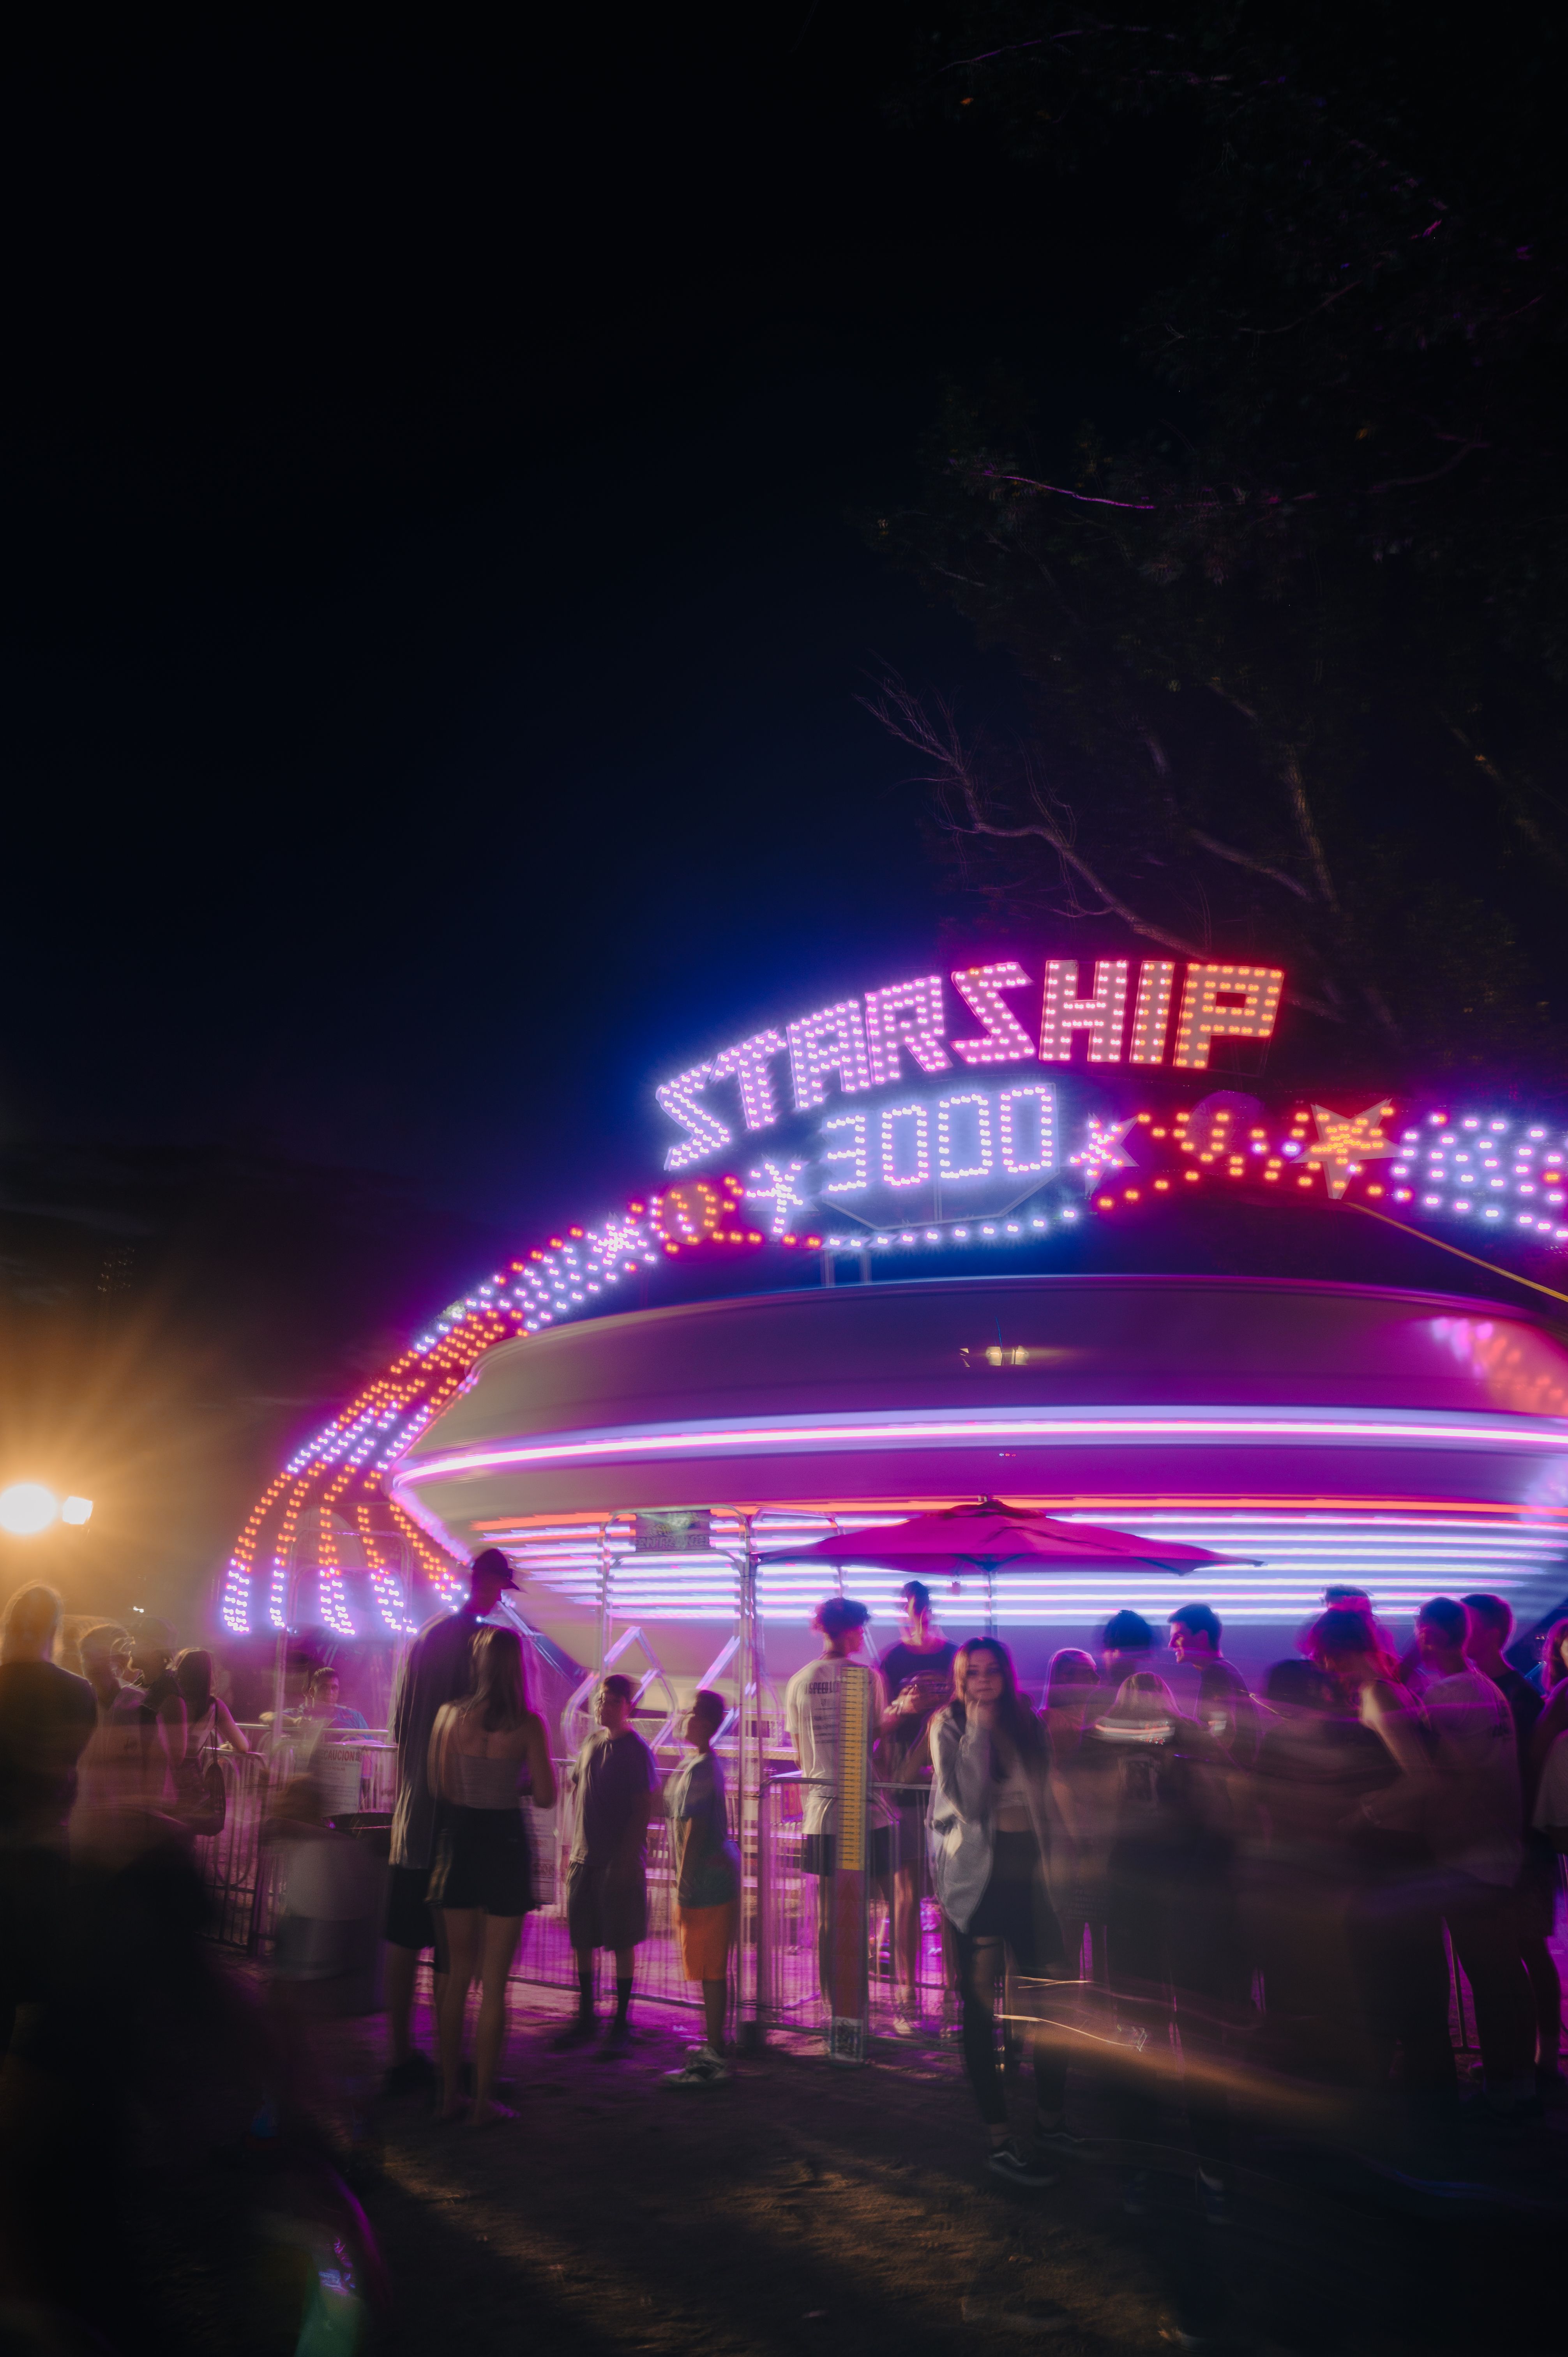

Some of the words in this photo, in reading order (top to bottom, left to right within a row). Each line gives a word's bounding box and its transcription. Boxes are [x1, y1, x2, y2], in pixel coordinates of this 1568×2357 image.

[656, 959, 1285, 1171] STARSHIP
[825, 1086, 1054, 1192] 3000
[809, 1682, 828, 1694] SPEED
